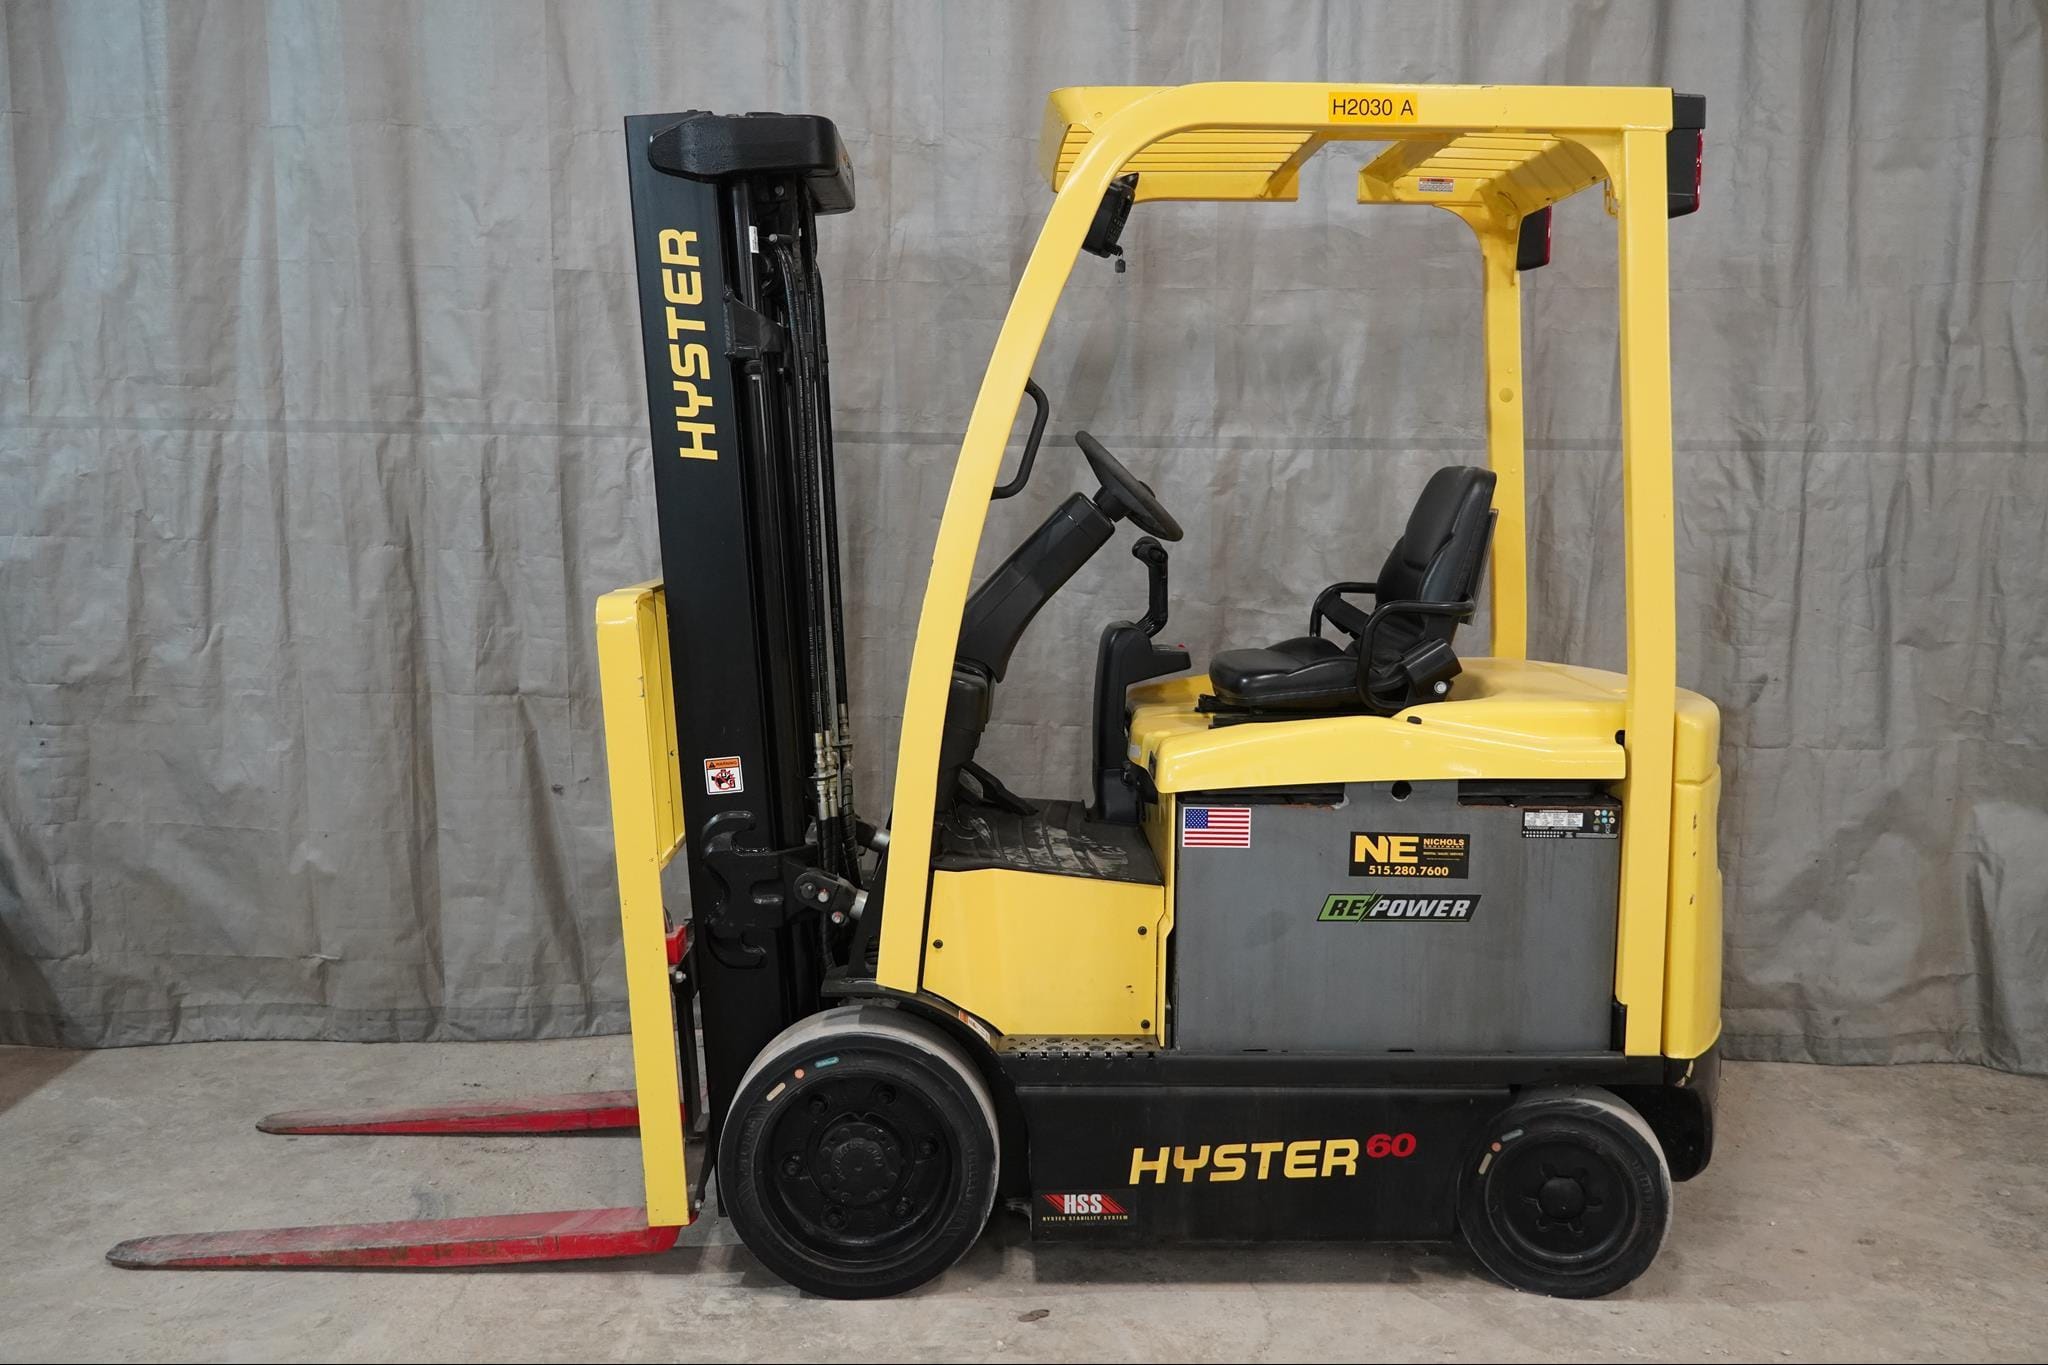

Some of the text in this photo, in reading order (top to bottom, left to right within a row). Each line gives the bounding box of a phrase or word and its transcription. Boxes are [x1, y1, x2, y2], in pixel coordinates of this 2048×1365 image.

[1332, 98, 1414, 116] H2030 A
[658, 228, 718, 460] HYSTER
[1354, 834, 1419, 863] NE
[1423, 838, 1465, 846] NICHOLS
[1368, 865, 1449, 877] 515.280.7600
[1129, 1133, 1416, 1185] HYSTER 60
[1063, 1193, 1103, 1214] HSS
